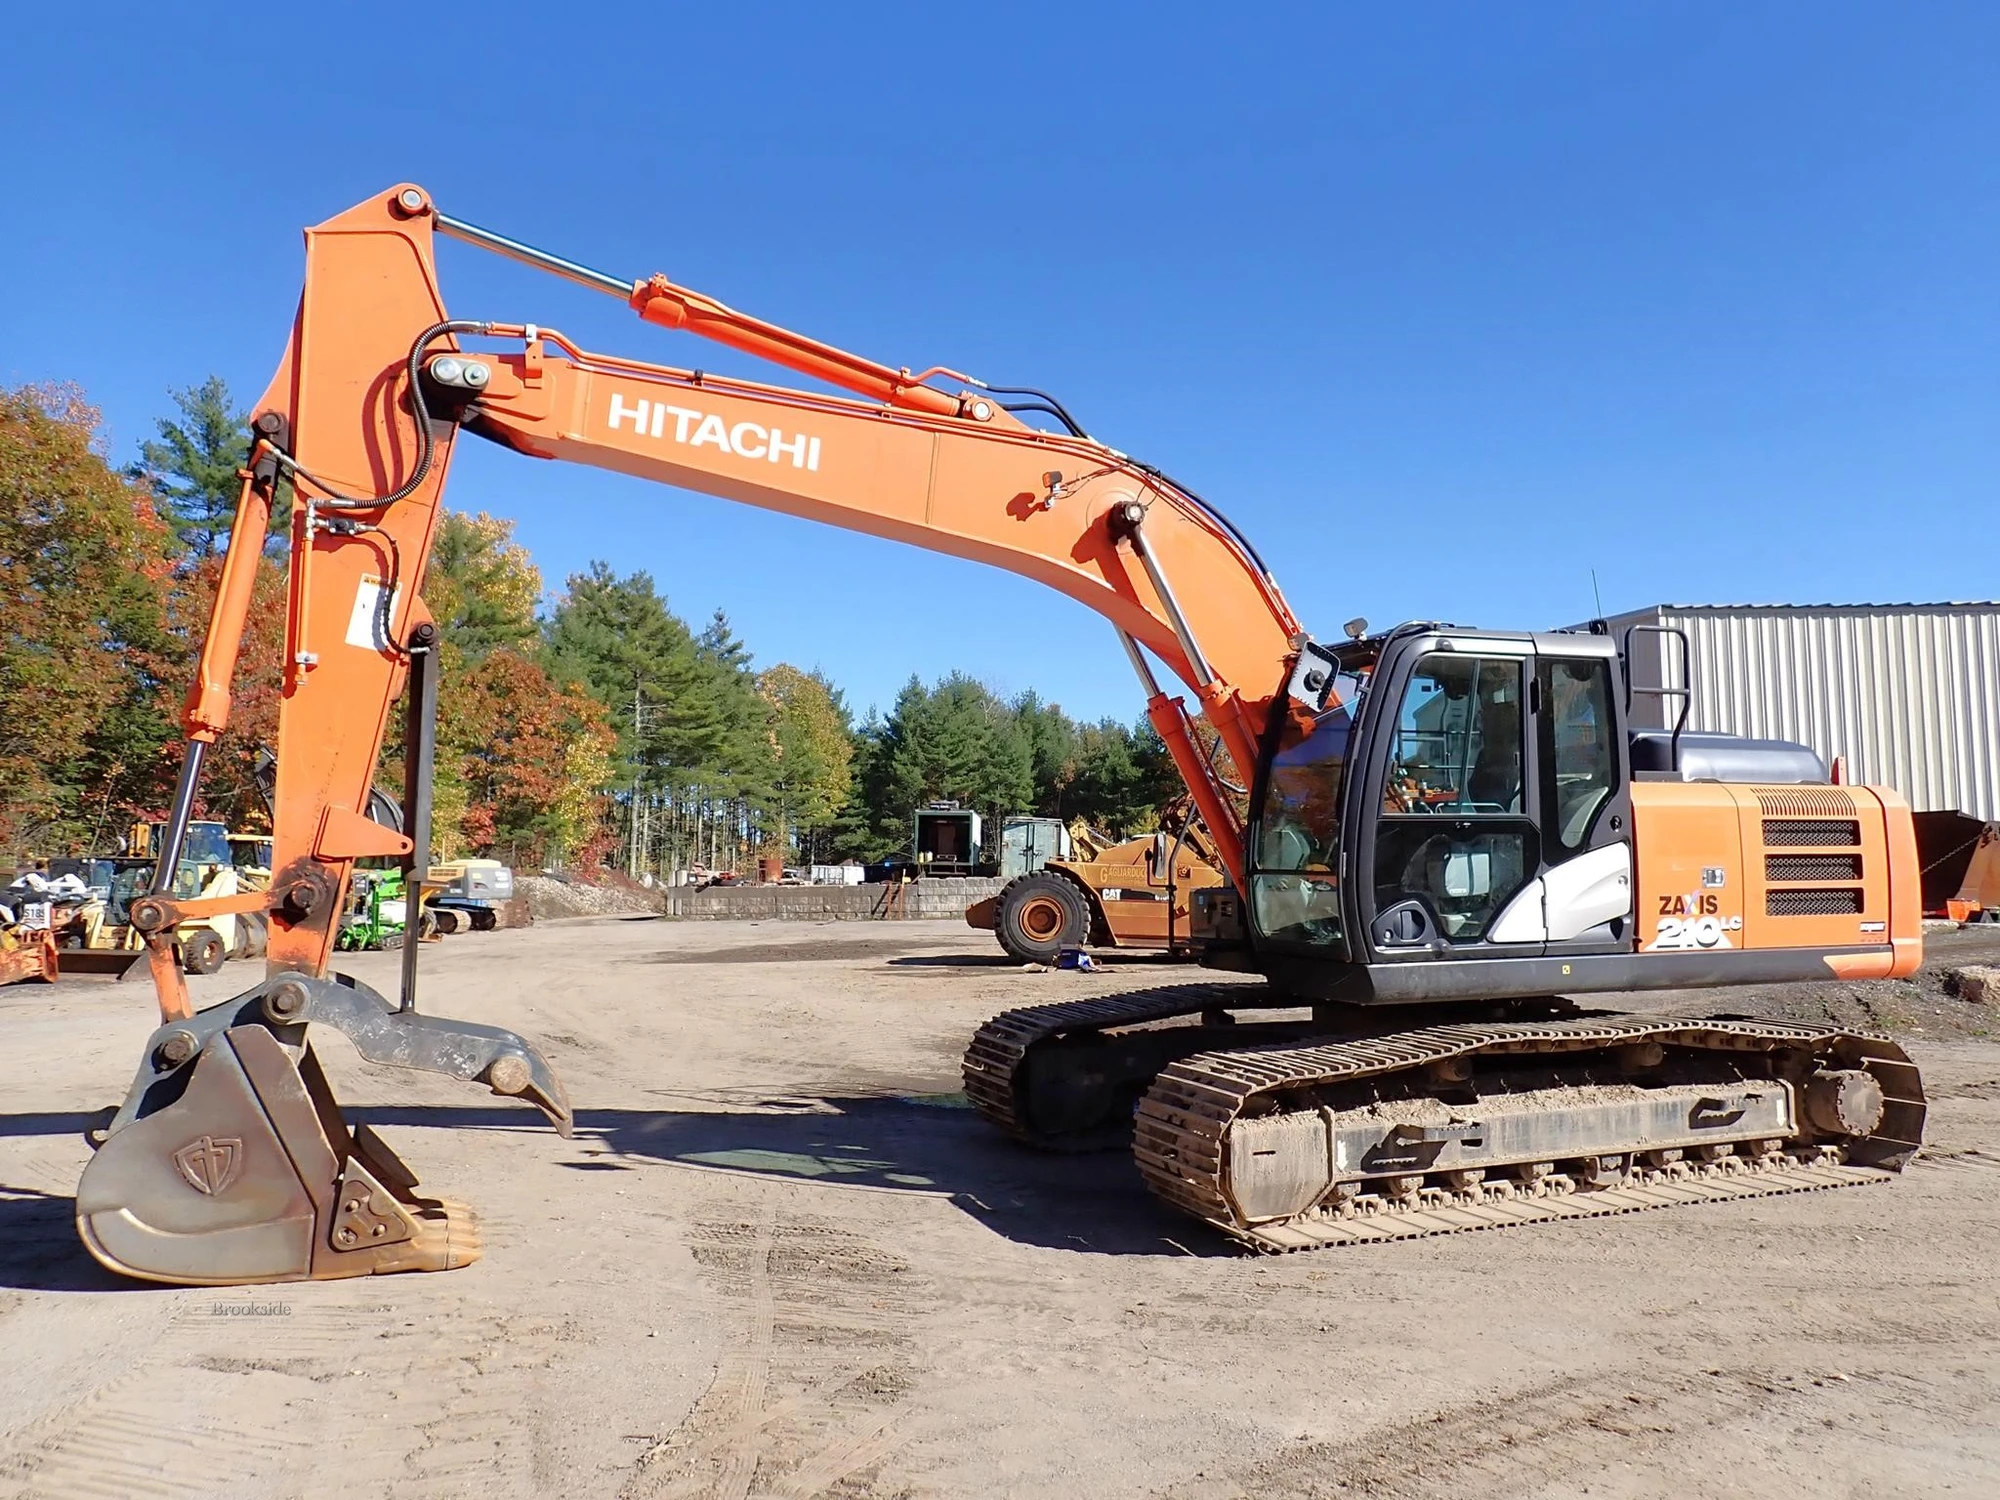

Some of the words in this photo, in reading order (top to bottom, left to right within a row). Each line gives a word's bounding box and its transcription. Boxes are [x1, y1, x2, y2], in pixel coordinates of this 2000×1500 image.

[607, 393, 821, 472] HITACHI
[1102, 888, 1122, 901] CAT
[1658, 889, 1718, 915] ZAXIS
